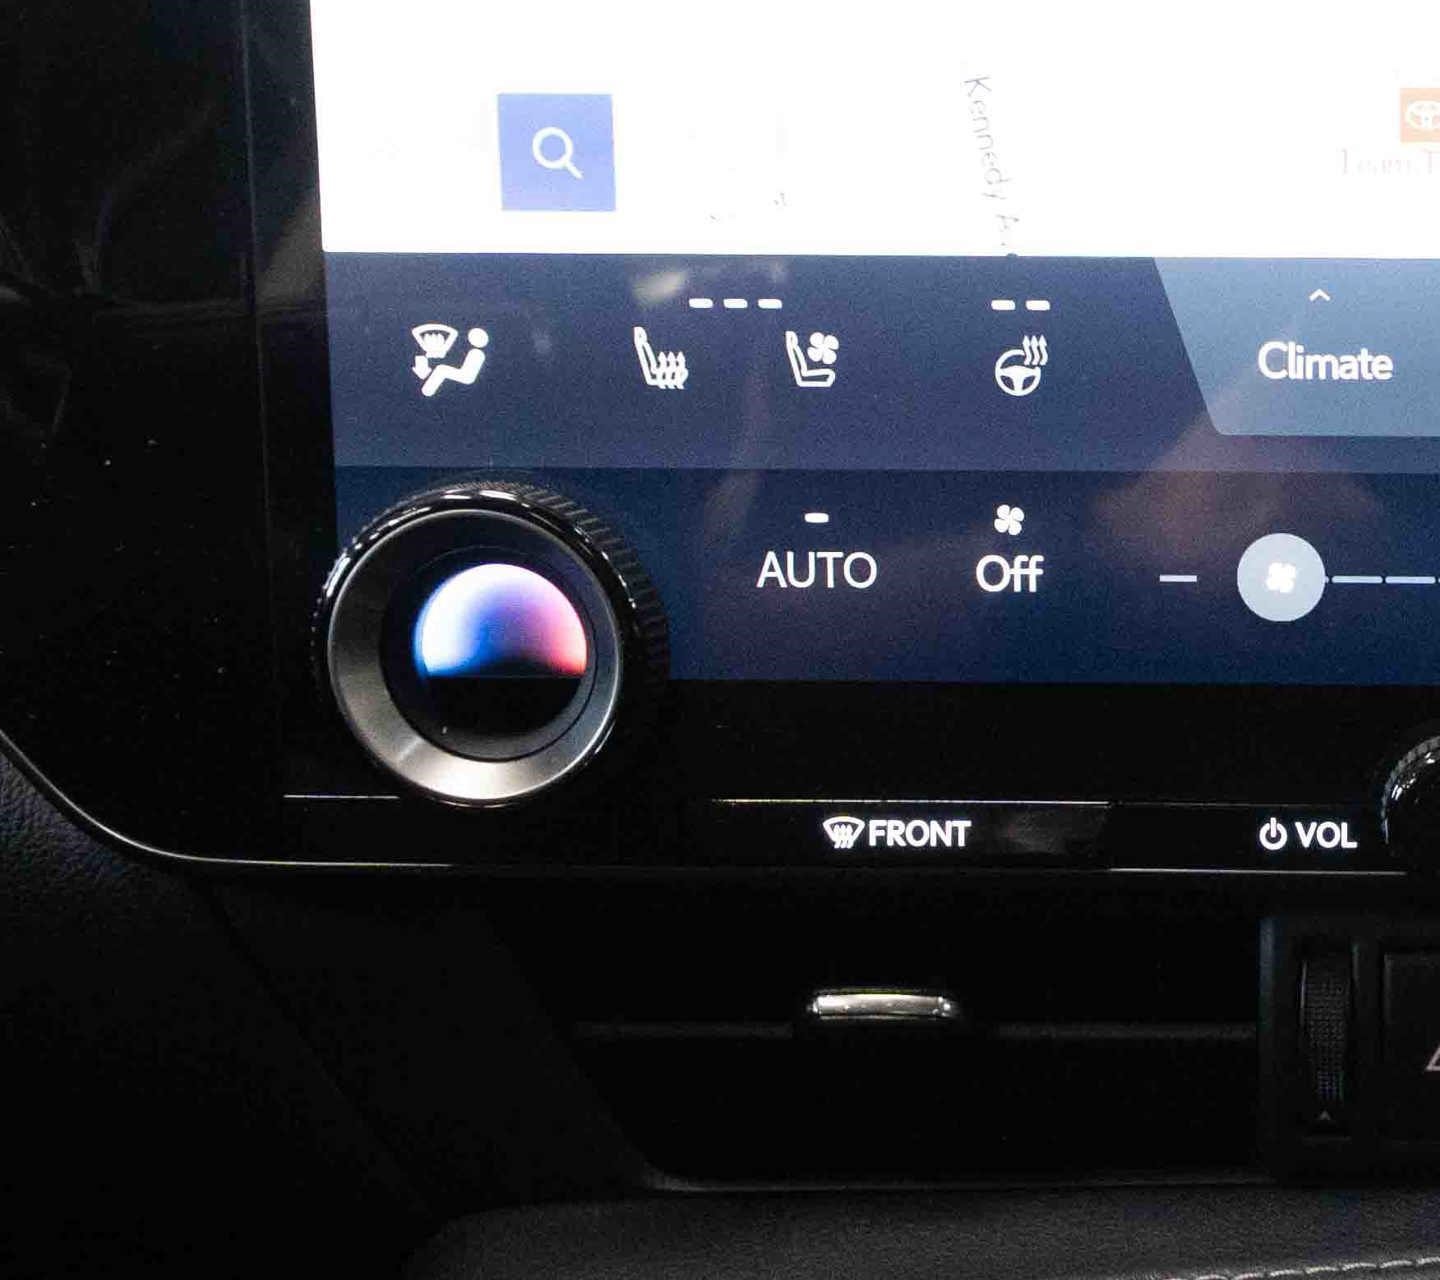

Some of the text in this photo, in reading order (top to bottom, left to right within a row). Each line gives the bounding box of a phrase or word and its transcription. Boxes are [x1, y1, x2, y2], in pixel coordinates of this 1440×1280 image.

[1257, 340, 1394, 381] Climate
[756, 551, 878, 589] AUTO
[975, 554, 1045, 594] Off
[868, 819, 972, 848] FRONT
[1294, 821, 1359, 849] VOL
